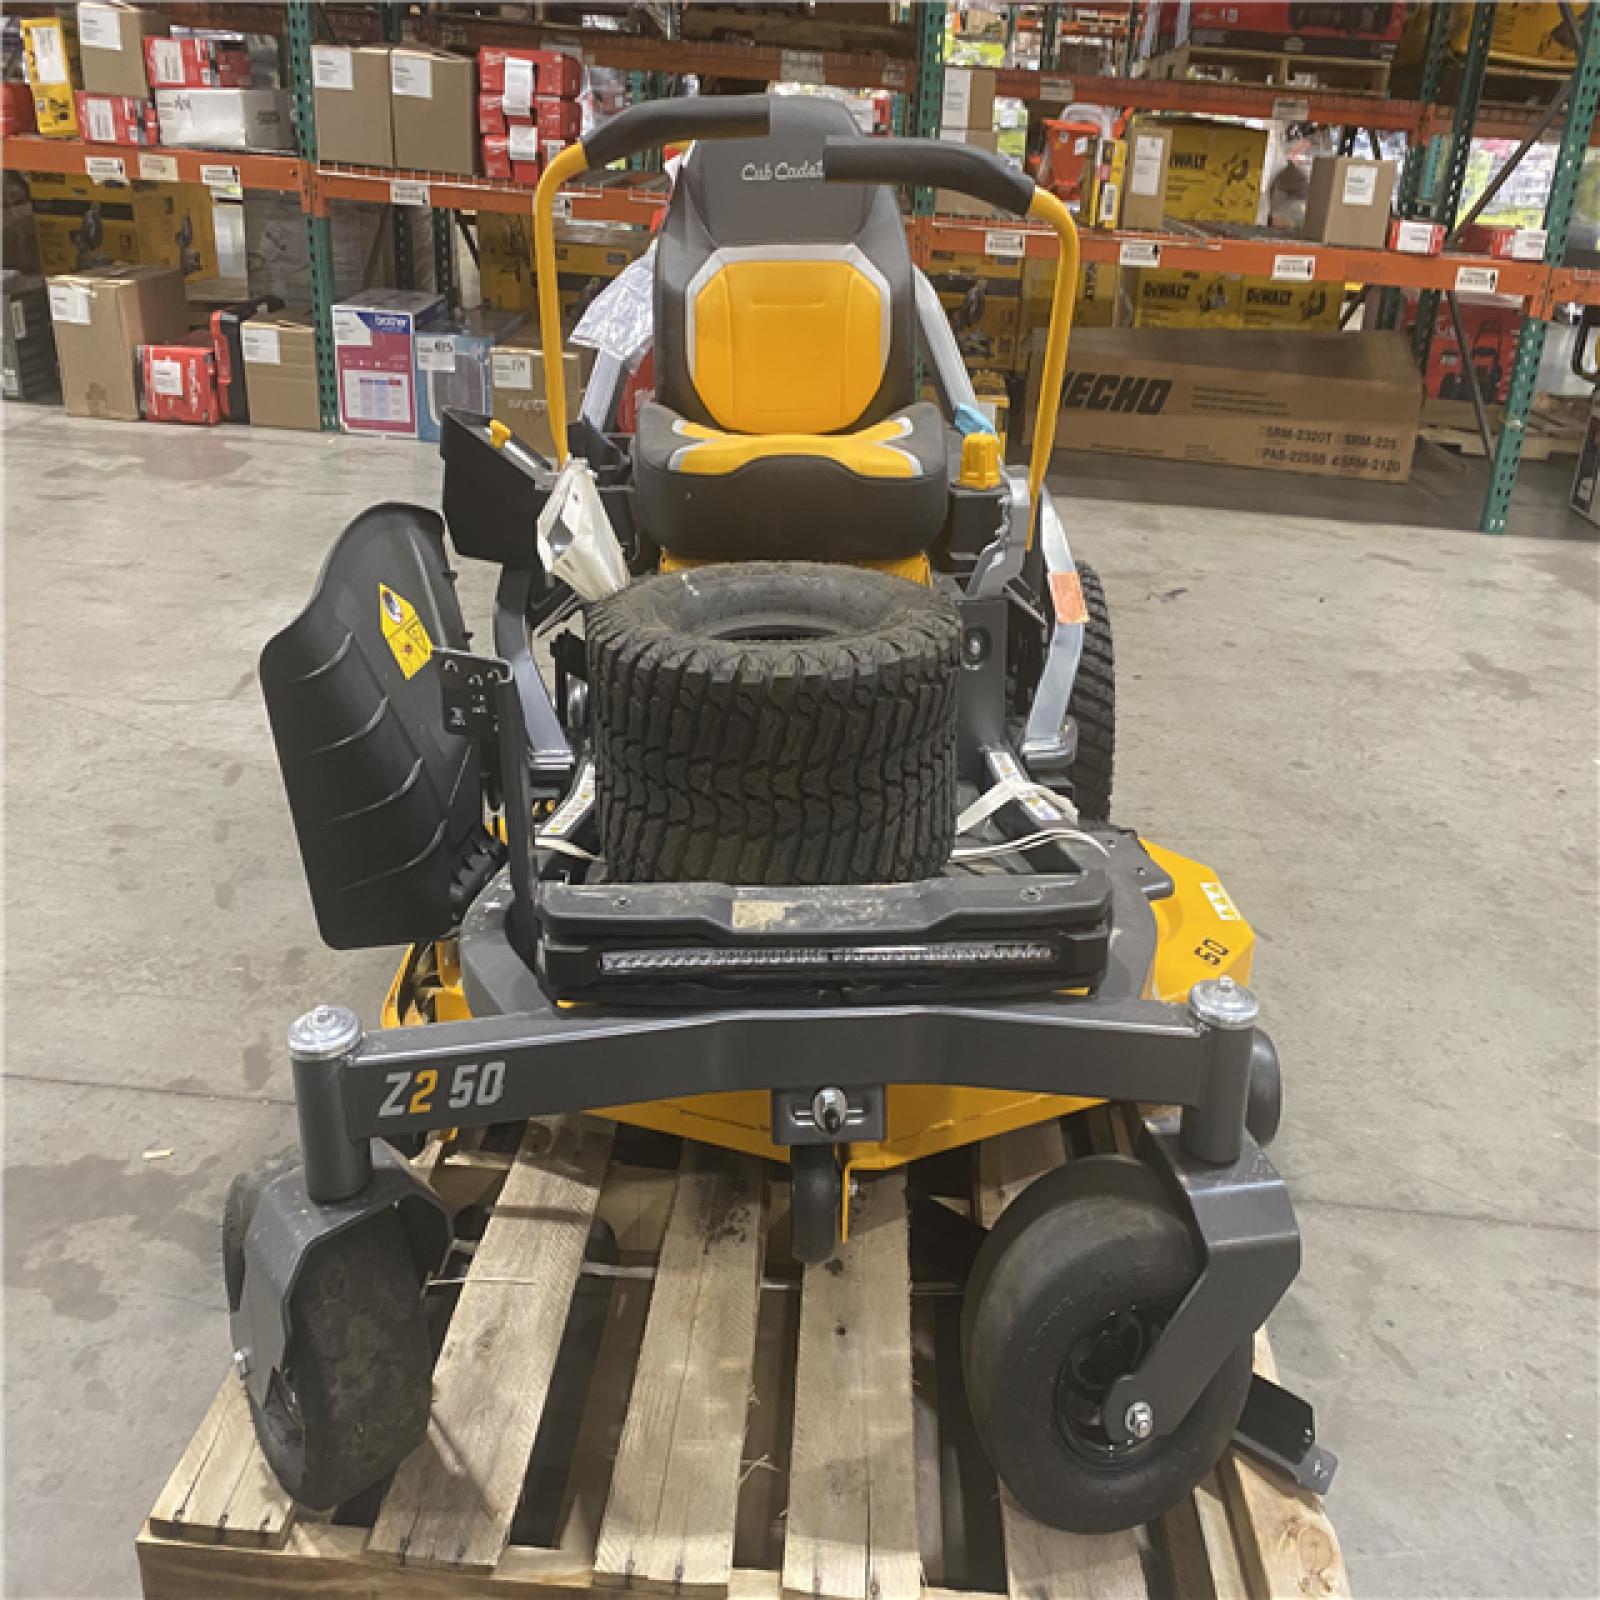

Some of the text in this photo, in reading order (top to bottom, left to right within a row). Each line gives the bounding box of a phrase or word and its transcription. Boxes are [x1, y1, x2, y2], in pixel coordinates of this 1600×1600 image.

[742, 162, 772, 181] Cub
[1064, 371, 1173, 415] ECHO
[1194, 937, 1229, 966] 50
[378, 1061, 506, 1117] Z2 50
